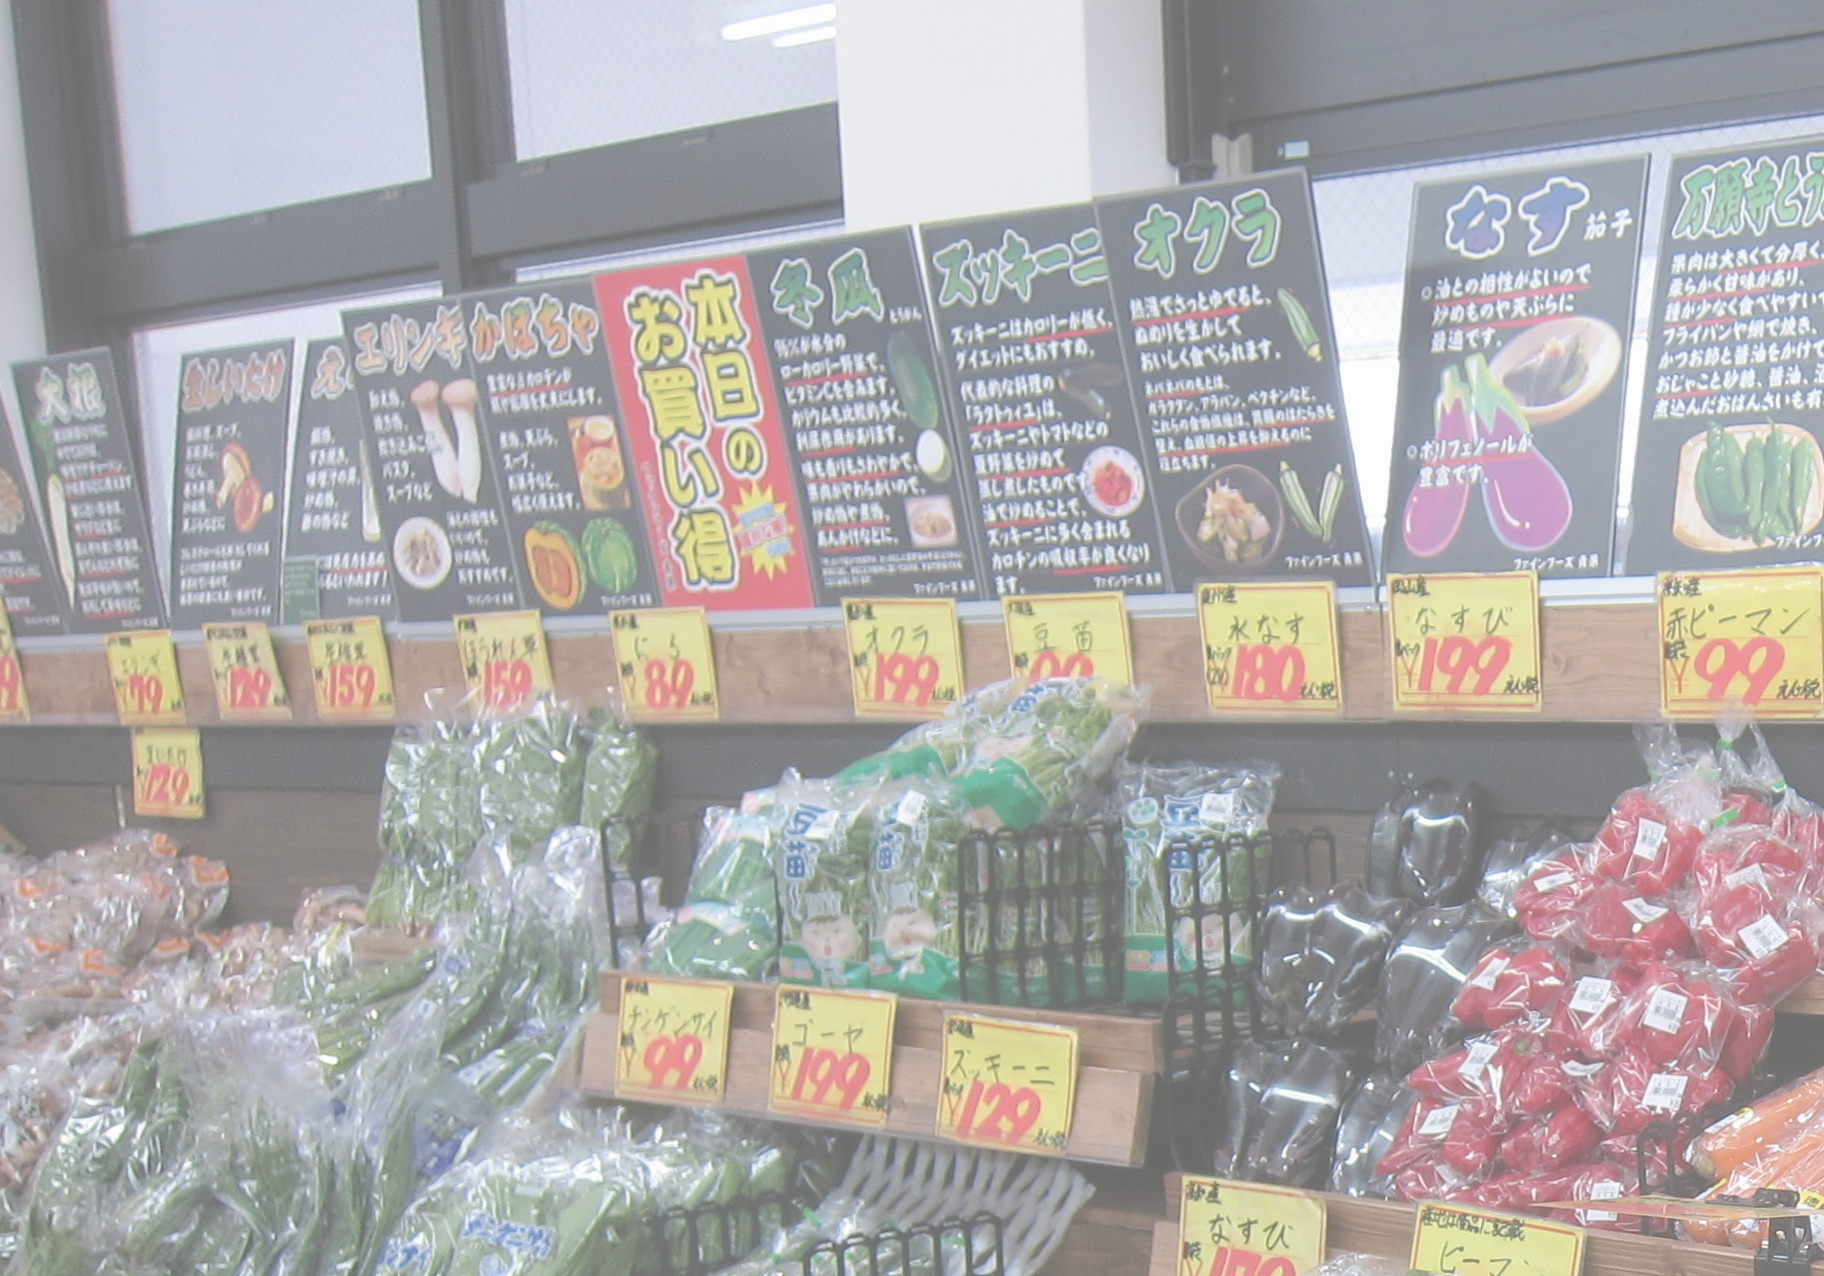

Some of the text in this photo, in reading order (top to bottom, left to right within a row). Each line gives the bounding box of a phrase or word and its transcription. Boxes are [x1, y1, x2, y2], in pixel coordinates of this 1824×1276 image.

[1133, 188, 1281, 279] オクラ
[1445, 176, 1634, 259] なす 茄子
[932, 228, 1109, 308] ズッキーニ
[1435, 262, 1591, 300] 油との相性がよいので
[1668, 266, 1805, 298] 柔らかく甘味があり、
[771, 247, 884, 329] 冬瓜
[1130, 285, 1271, 320] 熱湯でさっとゆでると、
[1432, 293, 1575, 326] 炒めものや天ぷらに
[353, 305, 467, 376] エリンギ
[471, 298, 600, 363] かぼちゃ
[1135, 313, 1242, 346] ぬめりを生かして
[1430, 325, 1503, 353] 最適です。
[1663, 315, 1817, 347] フライパンや網で焼き、
[1140, 339, 1281, 373] おいしく食べられます。
[682, 268, 766, 481] 本日の
[35, 362, 106, 424] 大根
[627, 285, 740, 591] お買い得
[1420, 433, 1532, 463] ポリフェノールが
[1418, 464, 1489, 488] 豊富です。
[1034, 620, 1094, 652] 豆苗
[1229, 613, 1305, 644] 水なす
[1415, 606, 1513, 636] なすび
[1667, 604, 1812, 640] 赤ピーマン
[866, 624, 929, 655] オクラ
[792, 1022, 866, 1055] ゴーヤ
[950, 1048, 1056, 1088] ズッキーニ
[1209, 1213, 1296, 1250] なすび
